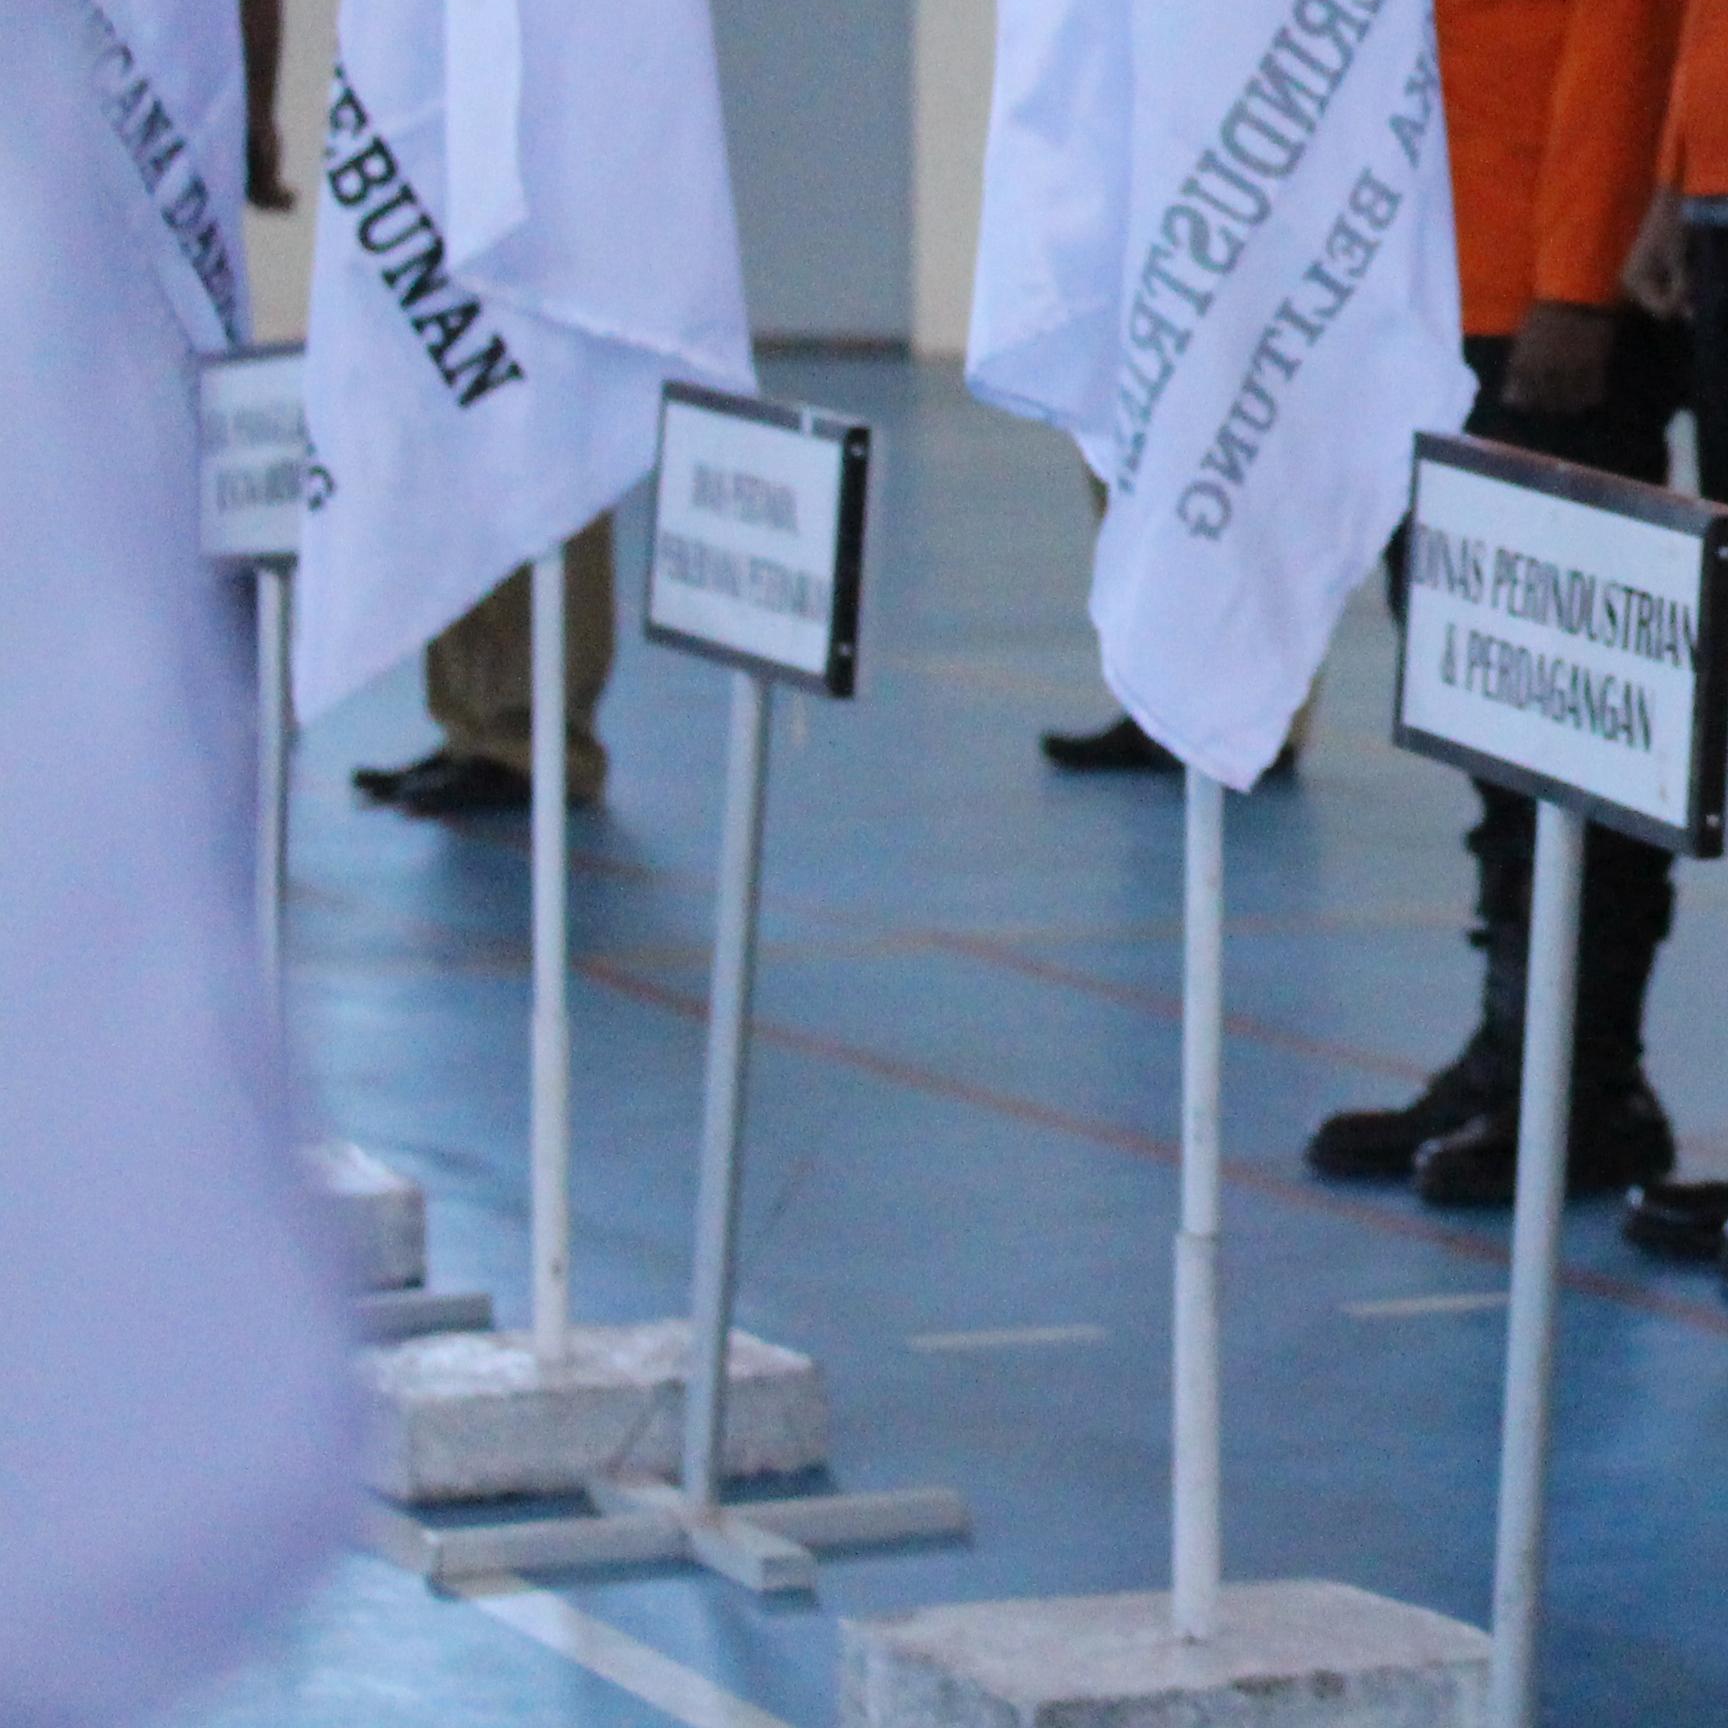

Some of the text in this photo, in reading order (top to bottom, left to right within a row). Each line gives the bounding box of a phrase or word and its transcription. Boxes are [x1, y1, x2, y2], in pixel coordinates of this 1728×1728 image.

[326, 60, 527, 410] EBUNAN
[1412, 522, 1700, 674] DINAS PERINDUSTRIAN
[1464, 628, 1653, 752] PERDAGANGAN
